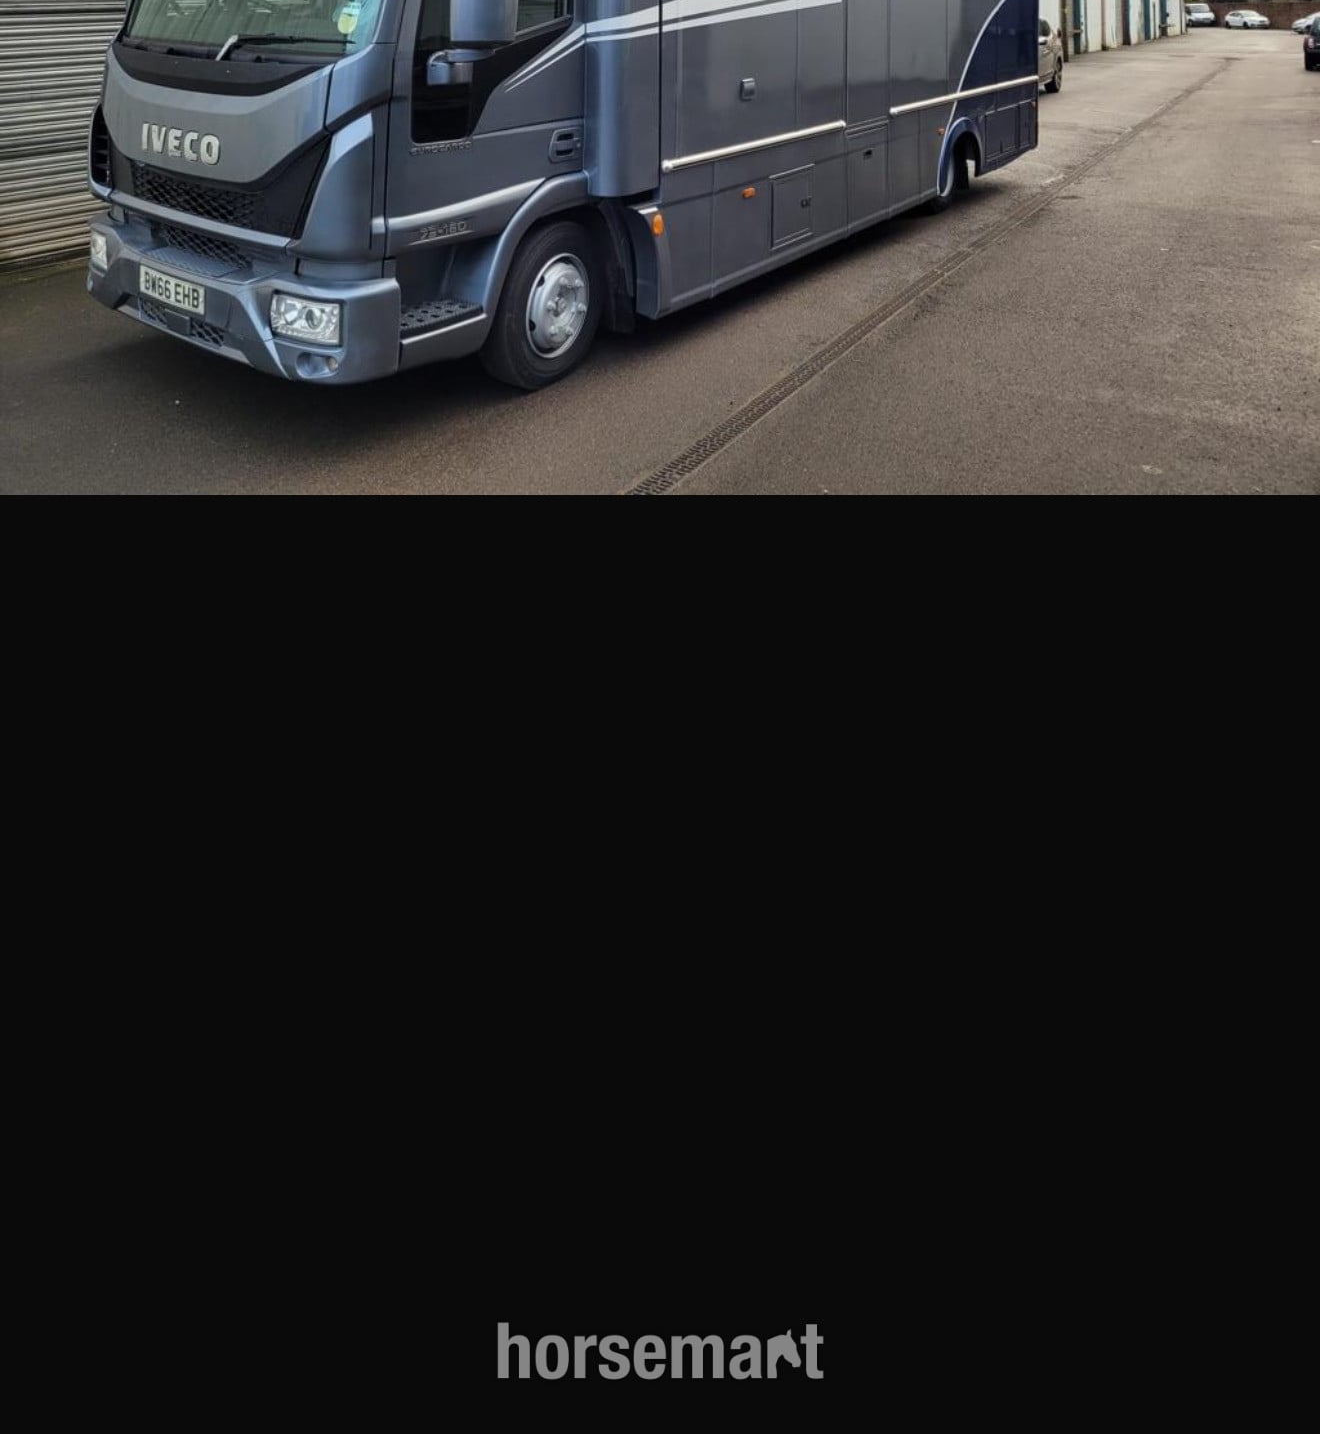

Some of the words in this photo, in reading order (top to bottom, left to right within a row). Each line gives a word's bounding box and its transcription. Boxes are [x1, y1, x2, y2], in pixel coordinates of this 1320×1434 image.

[142, 122, 220, 165] IVECO
[144, 271, 171, 299] BW66
[174, 282, 200, 309] EHB
